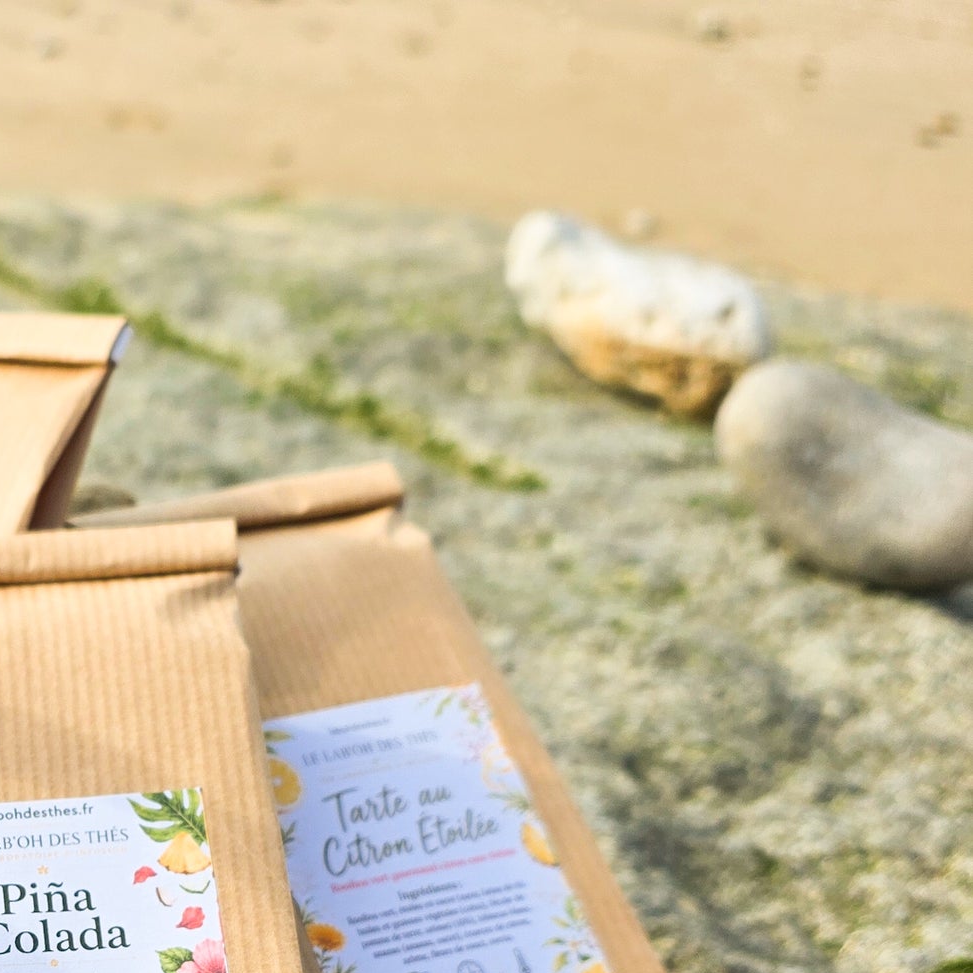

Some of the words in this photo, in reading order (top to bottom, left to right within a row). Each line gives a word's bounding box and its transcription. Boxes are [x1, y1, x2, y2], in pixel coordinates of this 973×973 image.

[321, 784, 407, 833] Tarte
[418, 785, 452, 807] au
[49, 831, 81, 847] DES
[85, 826, 129, 844] THÉS
[322, 832, 413, 878] Citron
